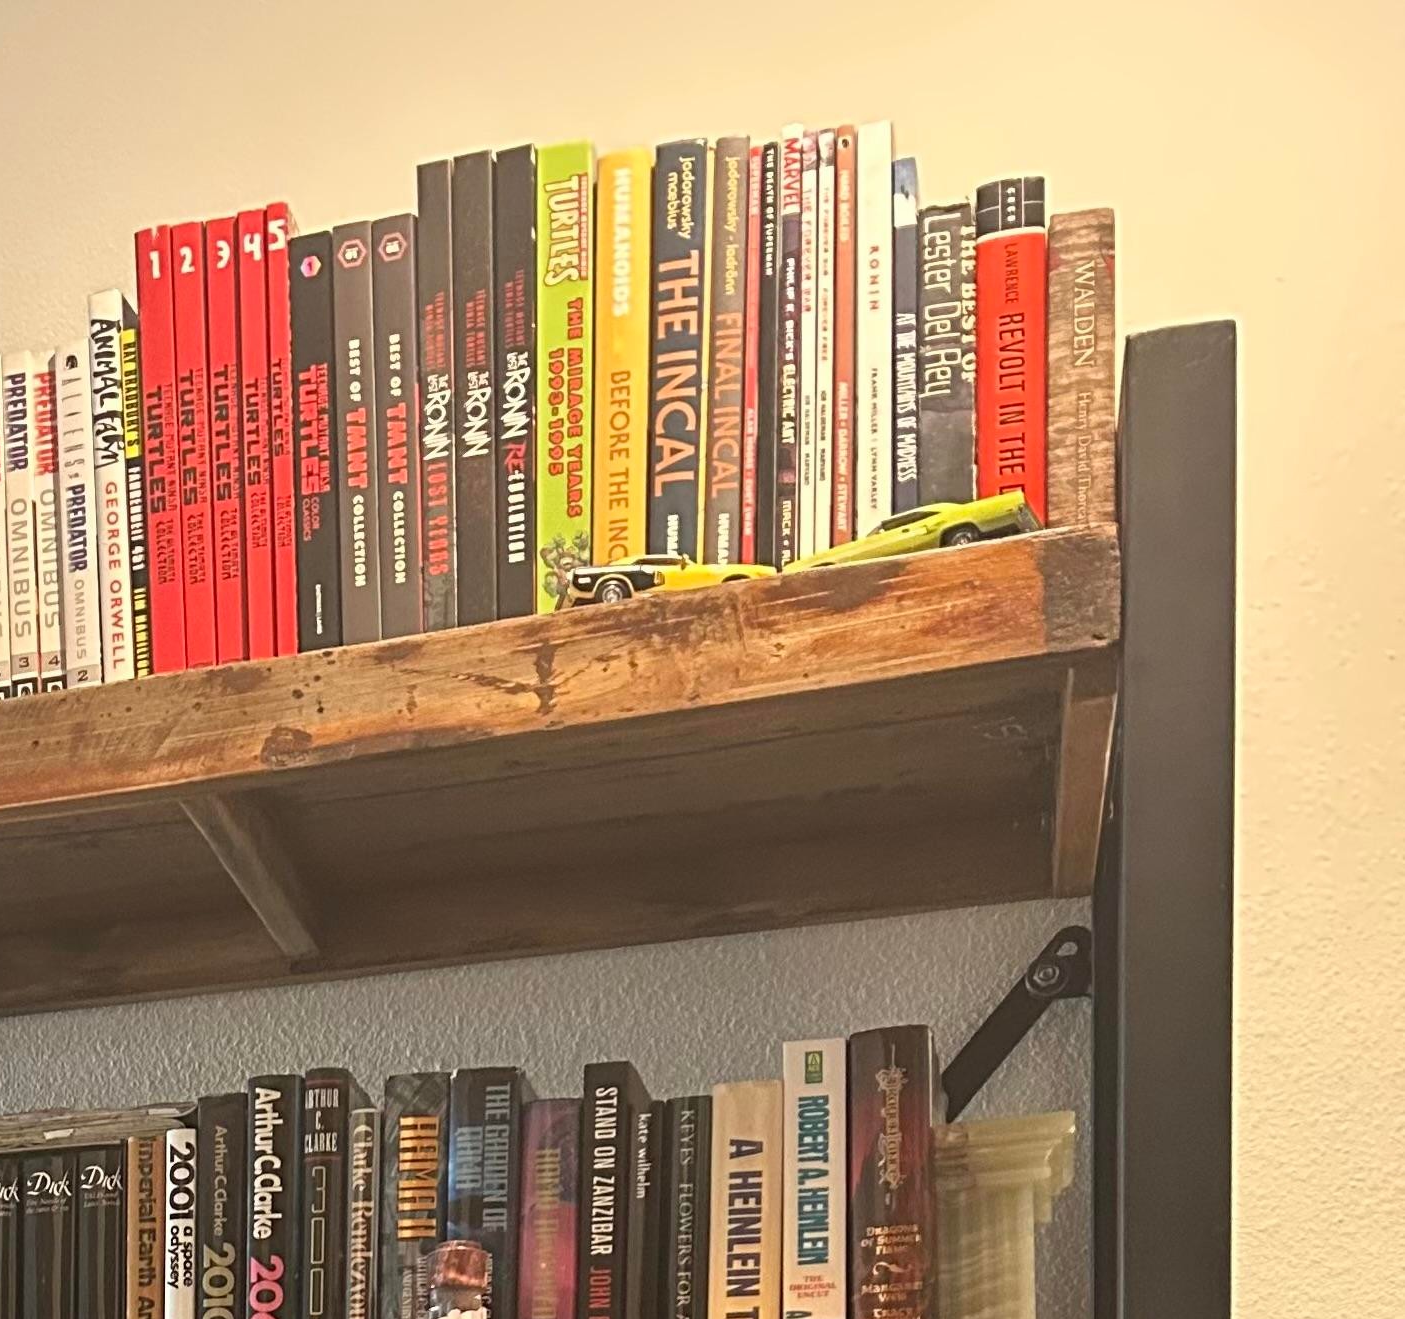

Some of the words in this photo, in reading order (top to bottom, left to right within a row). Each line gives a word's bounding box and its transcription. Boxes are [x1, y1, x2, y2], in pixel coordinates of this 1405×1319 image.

[666, 172, 677, 229] moebius
[680, 157, 696, 239] jodorowsky
[784, 138, 800, 215] MARVEL
[150, 252, 161, 278] 1
[180, 247, 194, 273] 2
[217, 241, 230, 267] 3
[244, 235, 261, 260] 4
[268, 220, 285, 250] 5
[611, 168, 631, 317] HUMANOIDS
[925, 213, 961, 293] Lester
[657, 250, 699, 341] THE
[868, 245, 879, 311] RONIN
[567, 298, 583, 340] THE
[924, 301, 960, 341] Del
[1072, 261, 1095, 366] WALDEN
[567, 348, 583, 422] MIRAGE
[920, 347, 961, 398] Rey
[998, 312, 1025, 391] REVOLT
[179, 370, 198, 505] TURTLES
[548, 349, 564, 477] 1993-1995
[653, 349, 698, 498] INCAL
[999, 402, 1025, 423] IN
[144, 385, 169, 514] TURTLES
[567, 430, 582, 518] YEARS
[1000, 431, 1025, 476] THE
[105, 482, 121, 569] GEORGE
[109, 582, 125, 670] ORWELL
[594, 1087, 618, 1138] STAND
[169, 1143, 194, 1221] 2001
[594, 1145, 615, 1168] ON
[729, 1138, 763, 1159] A
[183, 1226, 192, 1236] a
[590, 1176, 615, 1255] ZANZIBAR
[726, 1170, 762, 1296] HEINLEIN
[170, 1226, 179, 1288] odyssey
[183, 1241, 193, 1287] space
